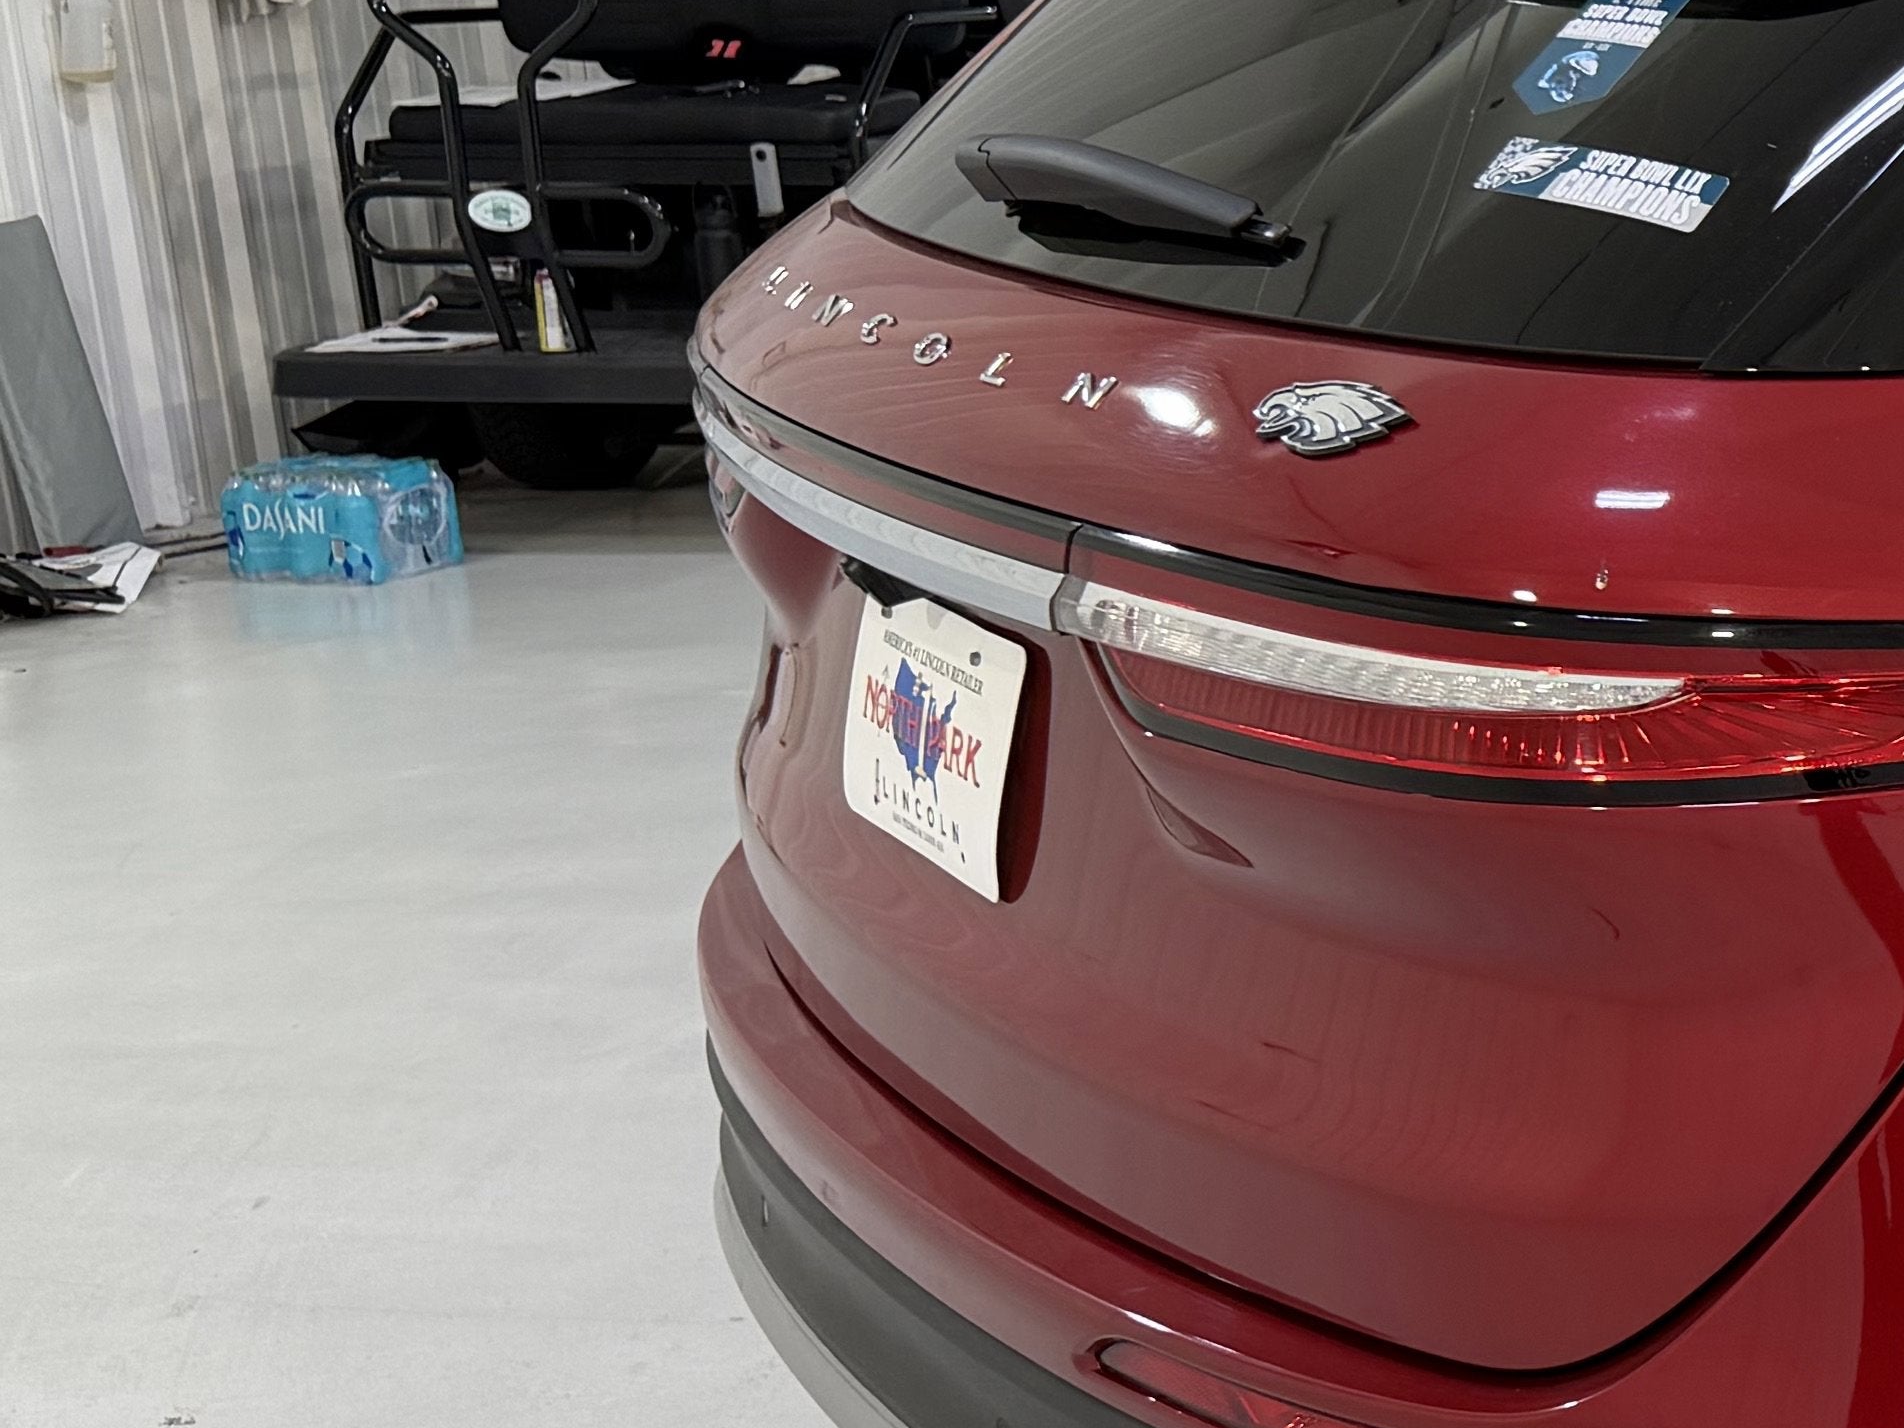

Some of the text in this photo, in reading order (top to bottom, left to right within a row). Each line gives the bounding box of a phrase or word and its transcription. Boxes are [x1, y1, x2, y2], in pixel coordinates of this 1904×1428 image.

[1550, 169, 1701, 225] CHAMPIONS
[1581, 149, 1712, 195] SUPER BOWL LIX
[762, 266, 1119, 410] LINCOLN
[242, 497, 325, 540] DASANI
[863, 674, 983, 788] NORTH PARK
[882, 775, 960, 845] LINCOLN
